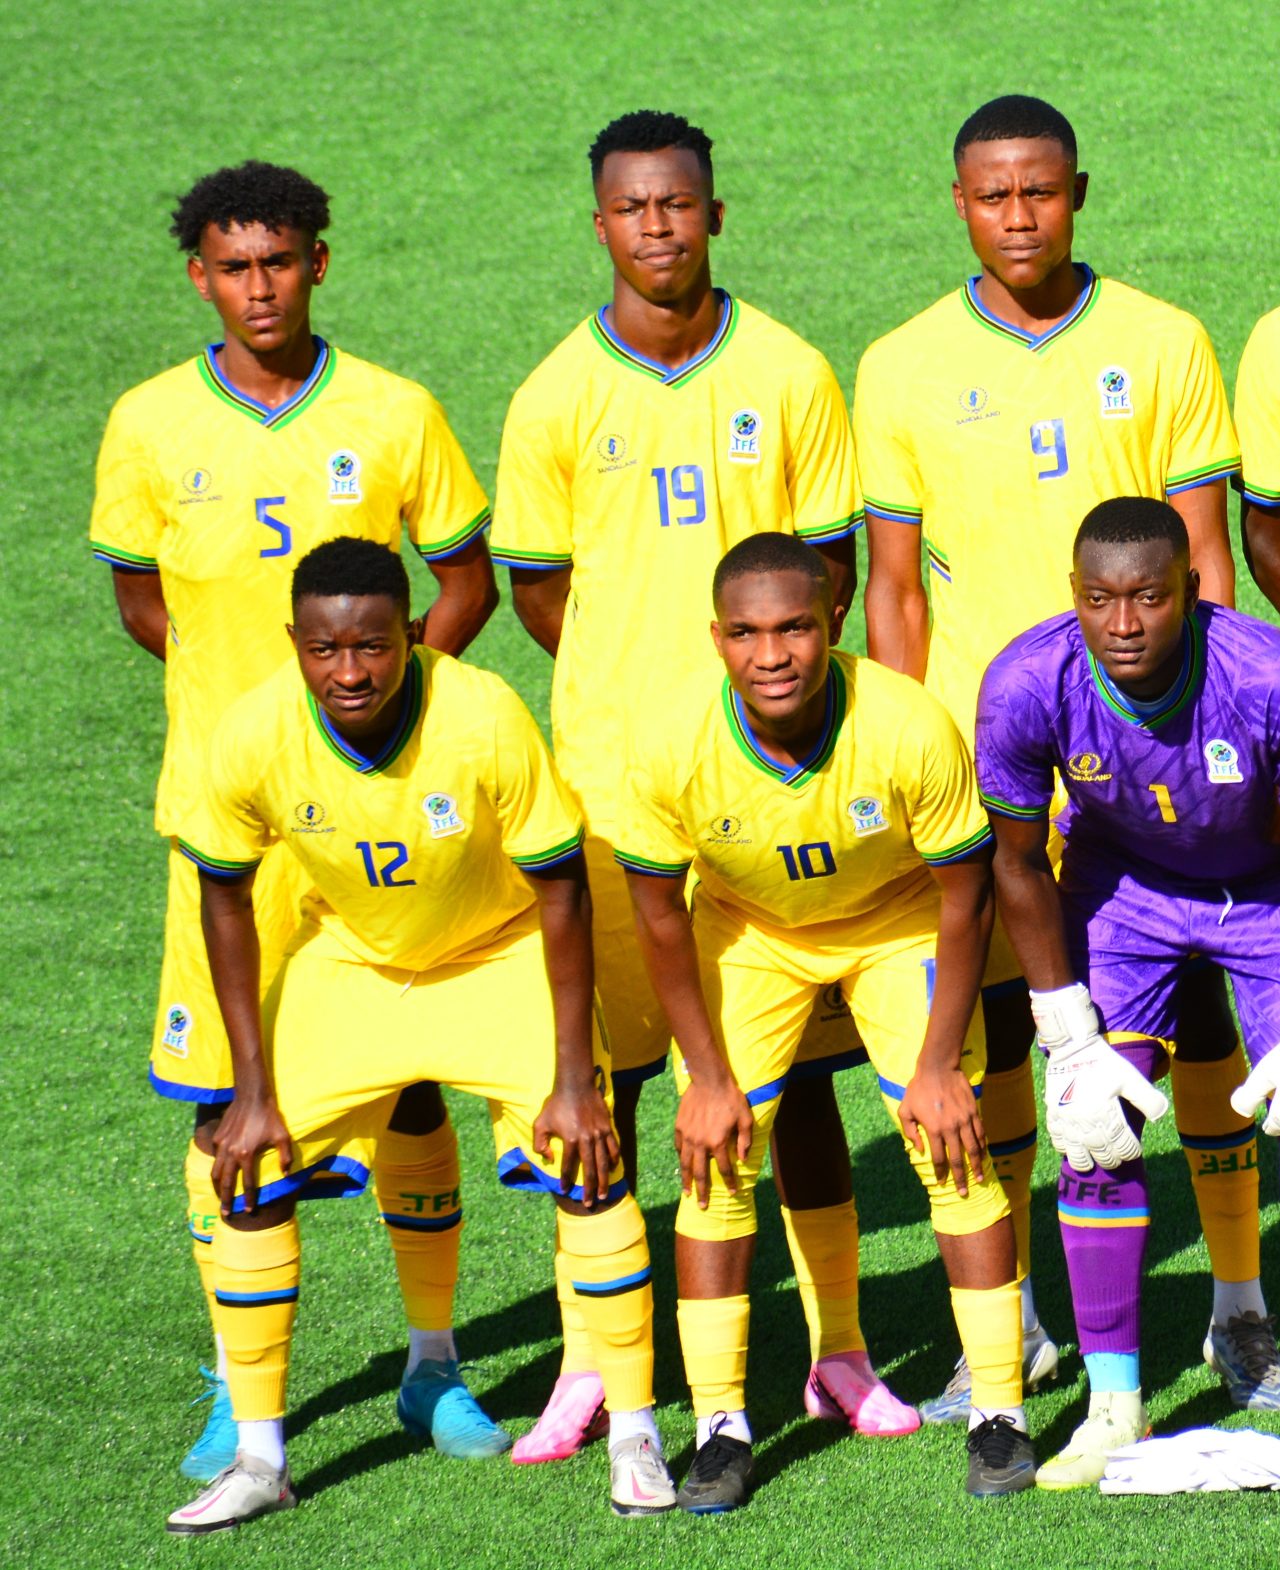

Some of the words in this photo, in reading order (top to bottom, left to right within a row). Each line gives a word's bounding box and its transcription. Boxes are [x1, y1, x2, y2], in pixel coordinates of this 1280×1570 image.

[1030, 418, 1068, 480] 9
[651, 464, 706, 527] 19
[255, 496, 292, 558] 5
[1149, 784, 1177, 823] 1
[355, 841, 417, 887] 12
[776, 841, 838, 881] 10
